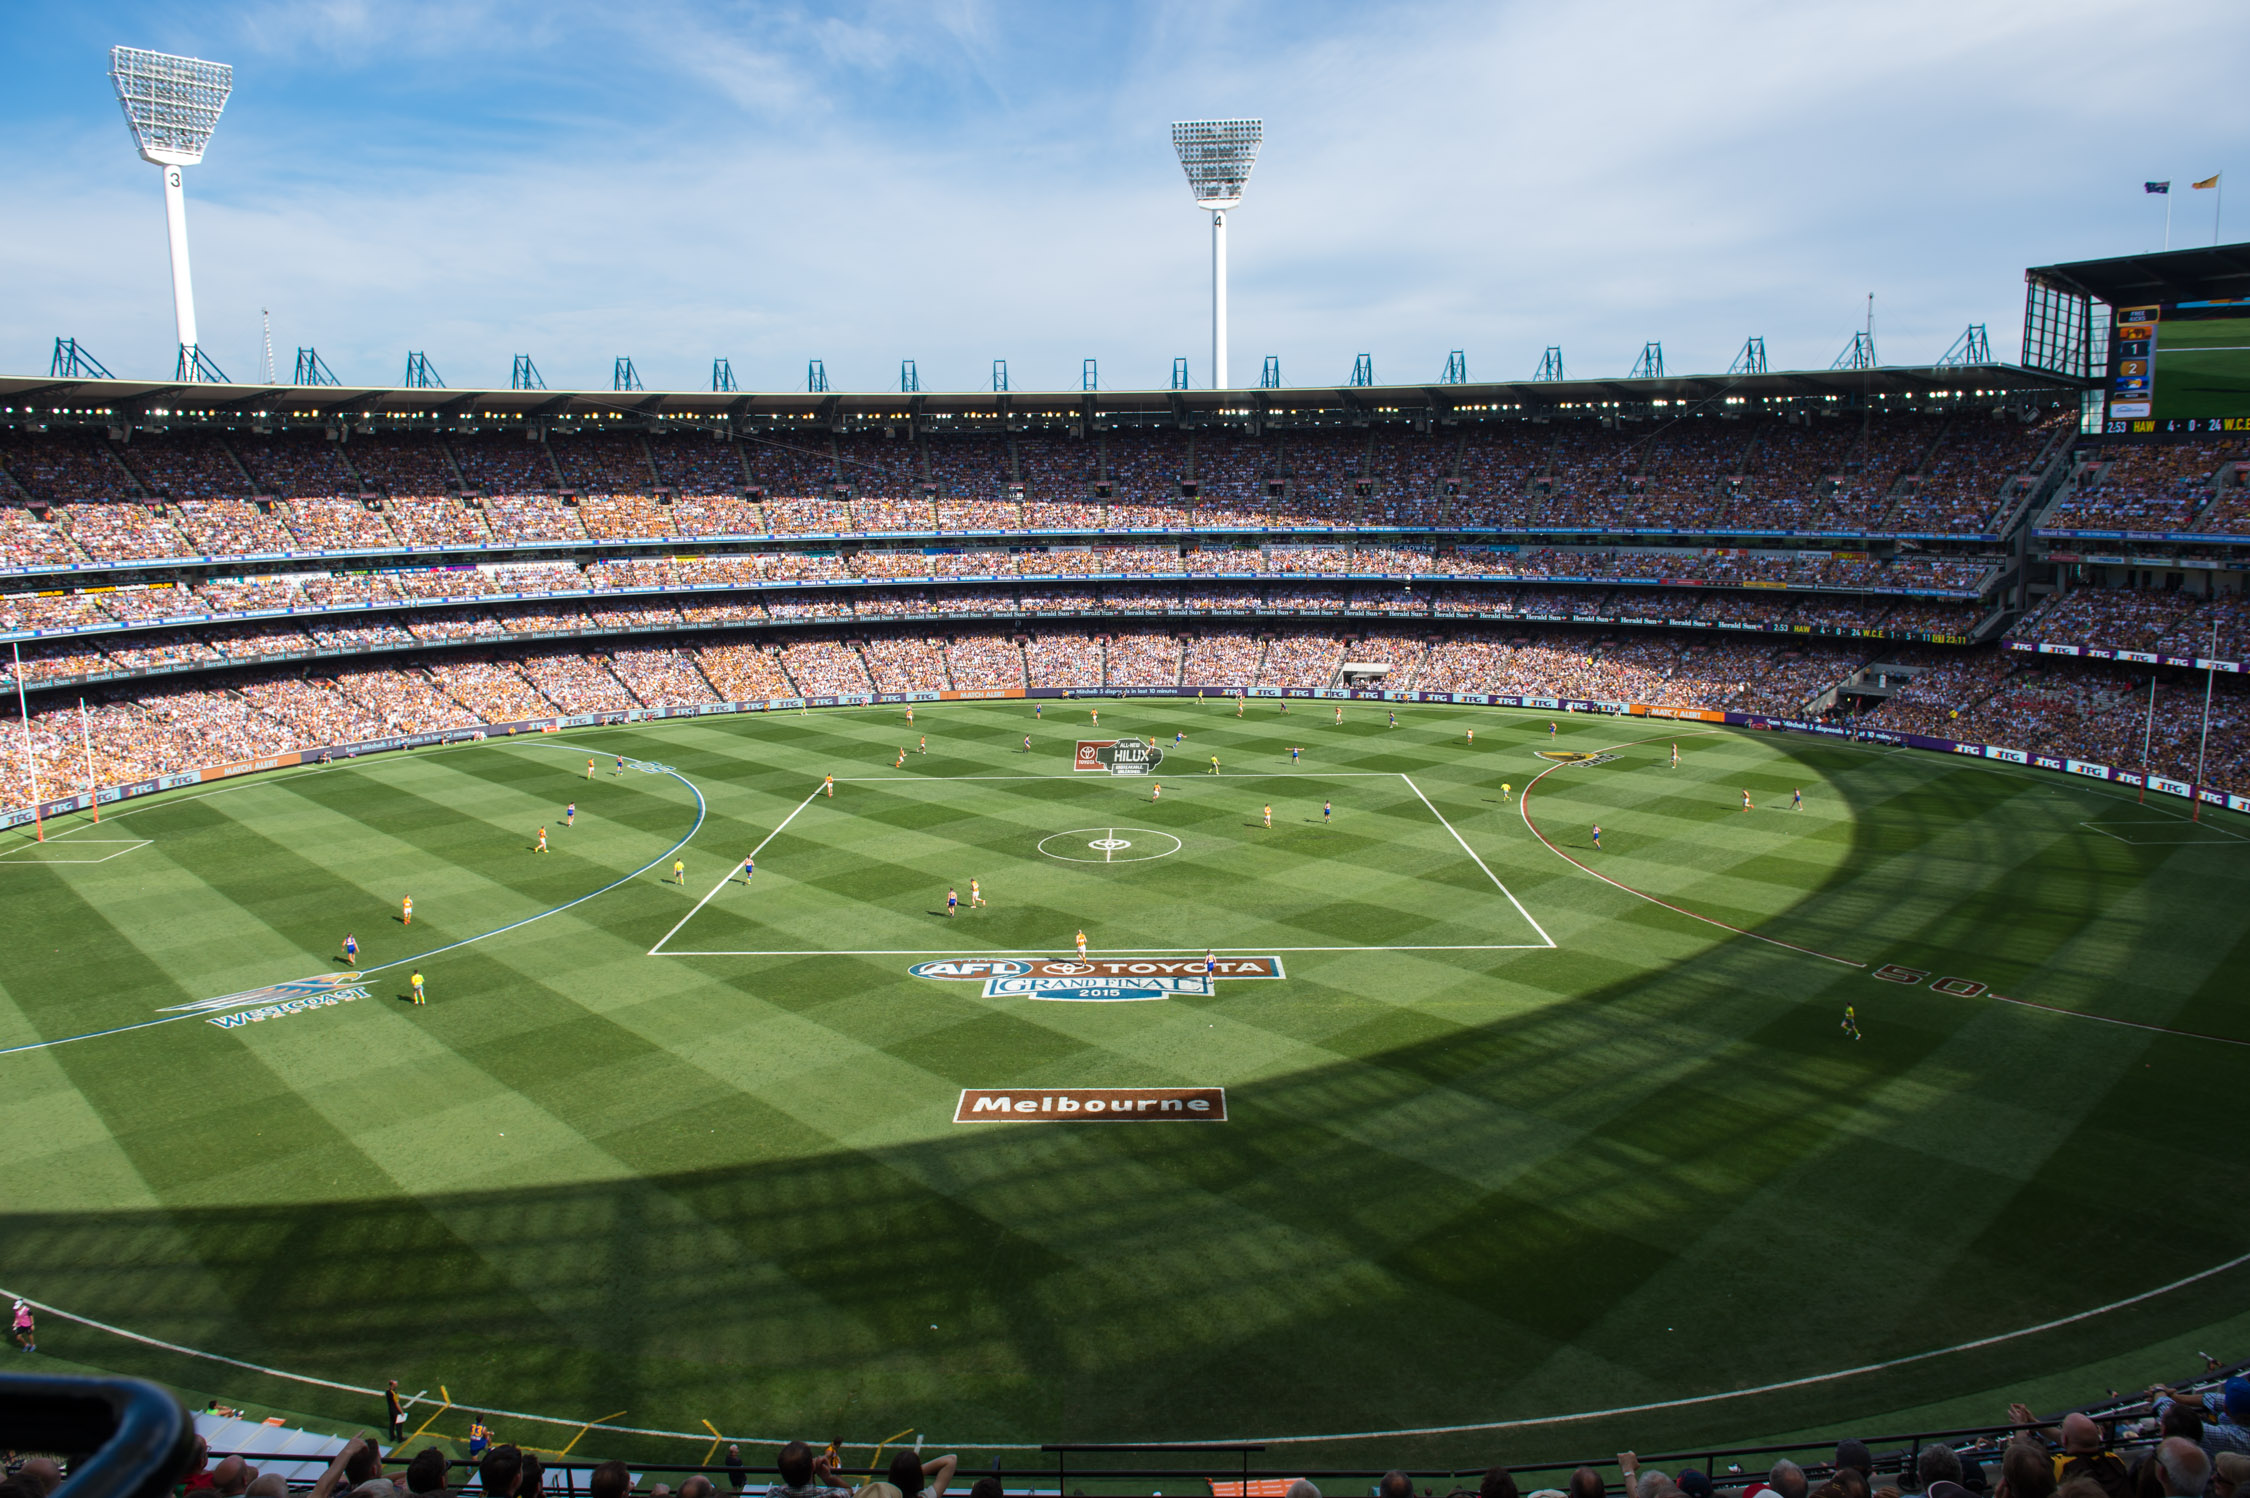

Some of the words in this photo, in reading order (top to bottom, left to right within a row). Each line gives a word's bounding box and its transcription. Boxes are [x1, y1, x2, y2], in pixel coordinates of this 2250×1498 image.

[170, 172, 180, 188] 3
[1214, 216, 1222, 228] 4
[2131, 344, 2138, 354] 1
[2128, 364, 2138, 374] 2
[2133, 420, 2156, 432] HAW
[2208, 419, 2222, 432] 24
[629, 625, 650, 633] Herald
[1852, 628, 1860, 636] 24
[532, 631, 556, 639] Herald
[422, 640, 447, 648] Herald
[315, 648, 341, 656] Herald
[342, 646, 356, 654] Sun
[203, 659, 230, 668] Herald
[230, 658, 246, 666] Sun
[86, 672, 114, 682] Herald
[114, 671, 130, 679] Sun
[24, 679, 52, 690] Herald
[54, 678, 70, 686] Sun
[960, 690, 984, 698] MATCH
[986, 690, 1005, 698] ALERT
[1652, 708, 1676, 717] MATC
[1680, 710, 1701, 719] ALERT
[1815, 725, 1844, 734] disposals
[1114, 750, 1149, 762] HILUX
[224, 764, 252, 776] MATCH
[254, 758, 278, 770] ALERT
[919, 962, 1021, 976] AFL
[1103, 962, 1265, 974] TOYOTA
[1000, 978, 1104, 992] GRAND
[1106, 976, 1203, 992] FINAL
[1872, 964, 1989, 998] 50
[1079, 988, 1120, 997] 2015
[972, 1096, 1211, 1113] Melbourne
